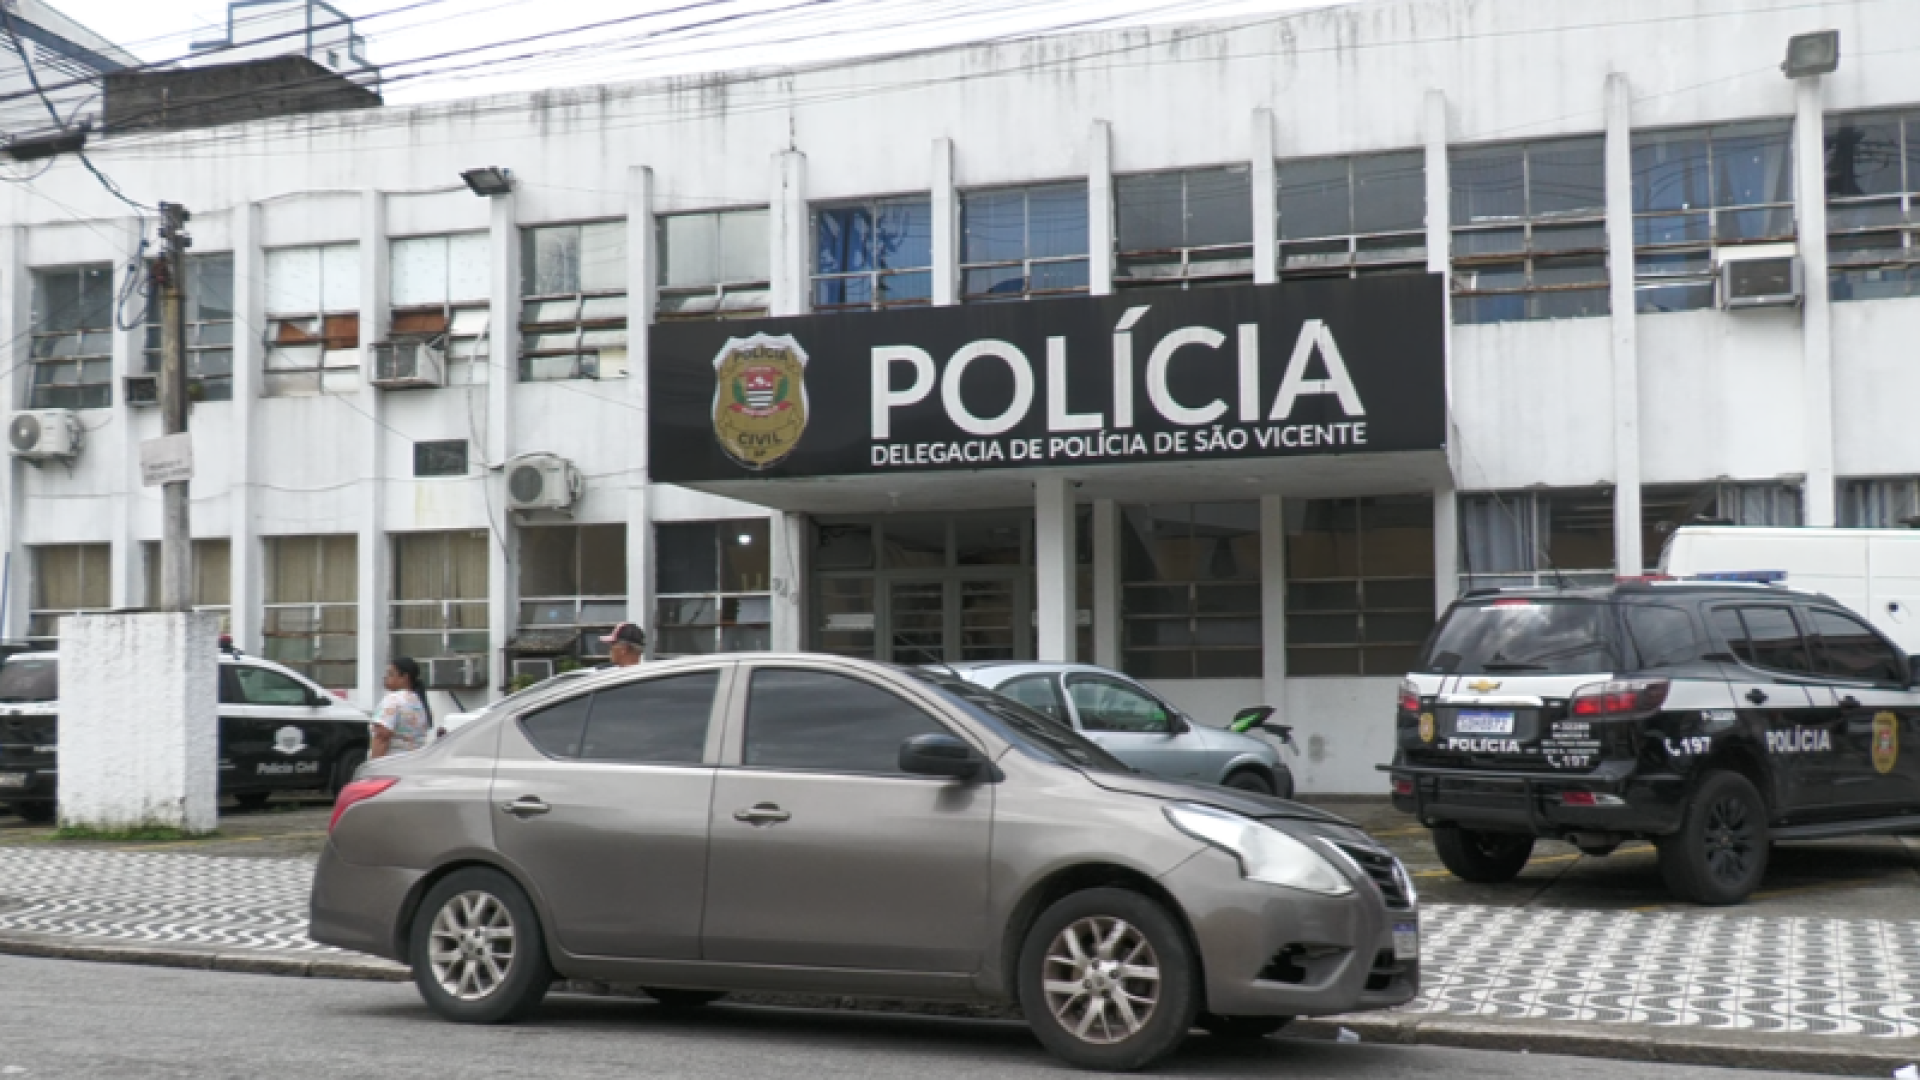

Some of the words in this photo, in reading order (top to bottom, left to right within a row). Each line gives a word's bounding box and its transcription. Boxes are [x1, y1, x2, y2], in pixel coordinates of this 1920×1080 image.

[871, 304, 1367, 440] POLÍCIA
[738, 431, 782, 446] CIVIL
[871, 440, 1004, 467] DELEGACIA
[1010, 438, 1043, 460] DE
[1049, 430, 1148, 459] POLÍCIA
[1154, 431, 1188, 455] DE
[1194, 424, 1249, 451] SÃO
[1253, 422, 1368, 449] VICENTE
[1449, 736, 1520, 752] POLÍCIA
[1682, 736, 1711, 755] 197
[1766, 726, 1831, 752] POLÍCIA
[1562, 755, 1590, 767] 197
